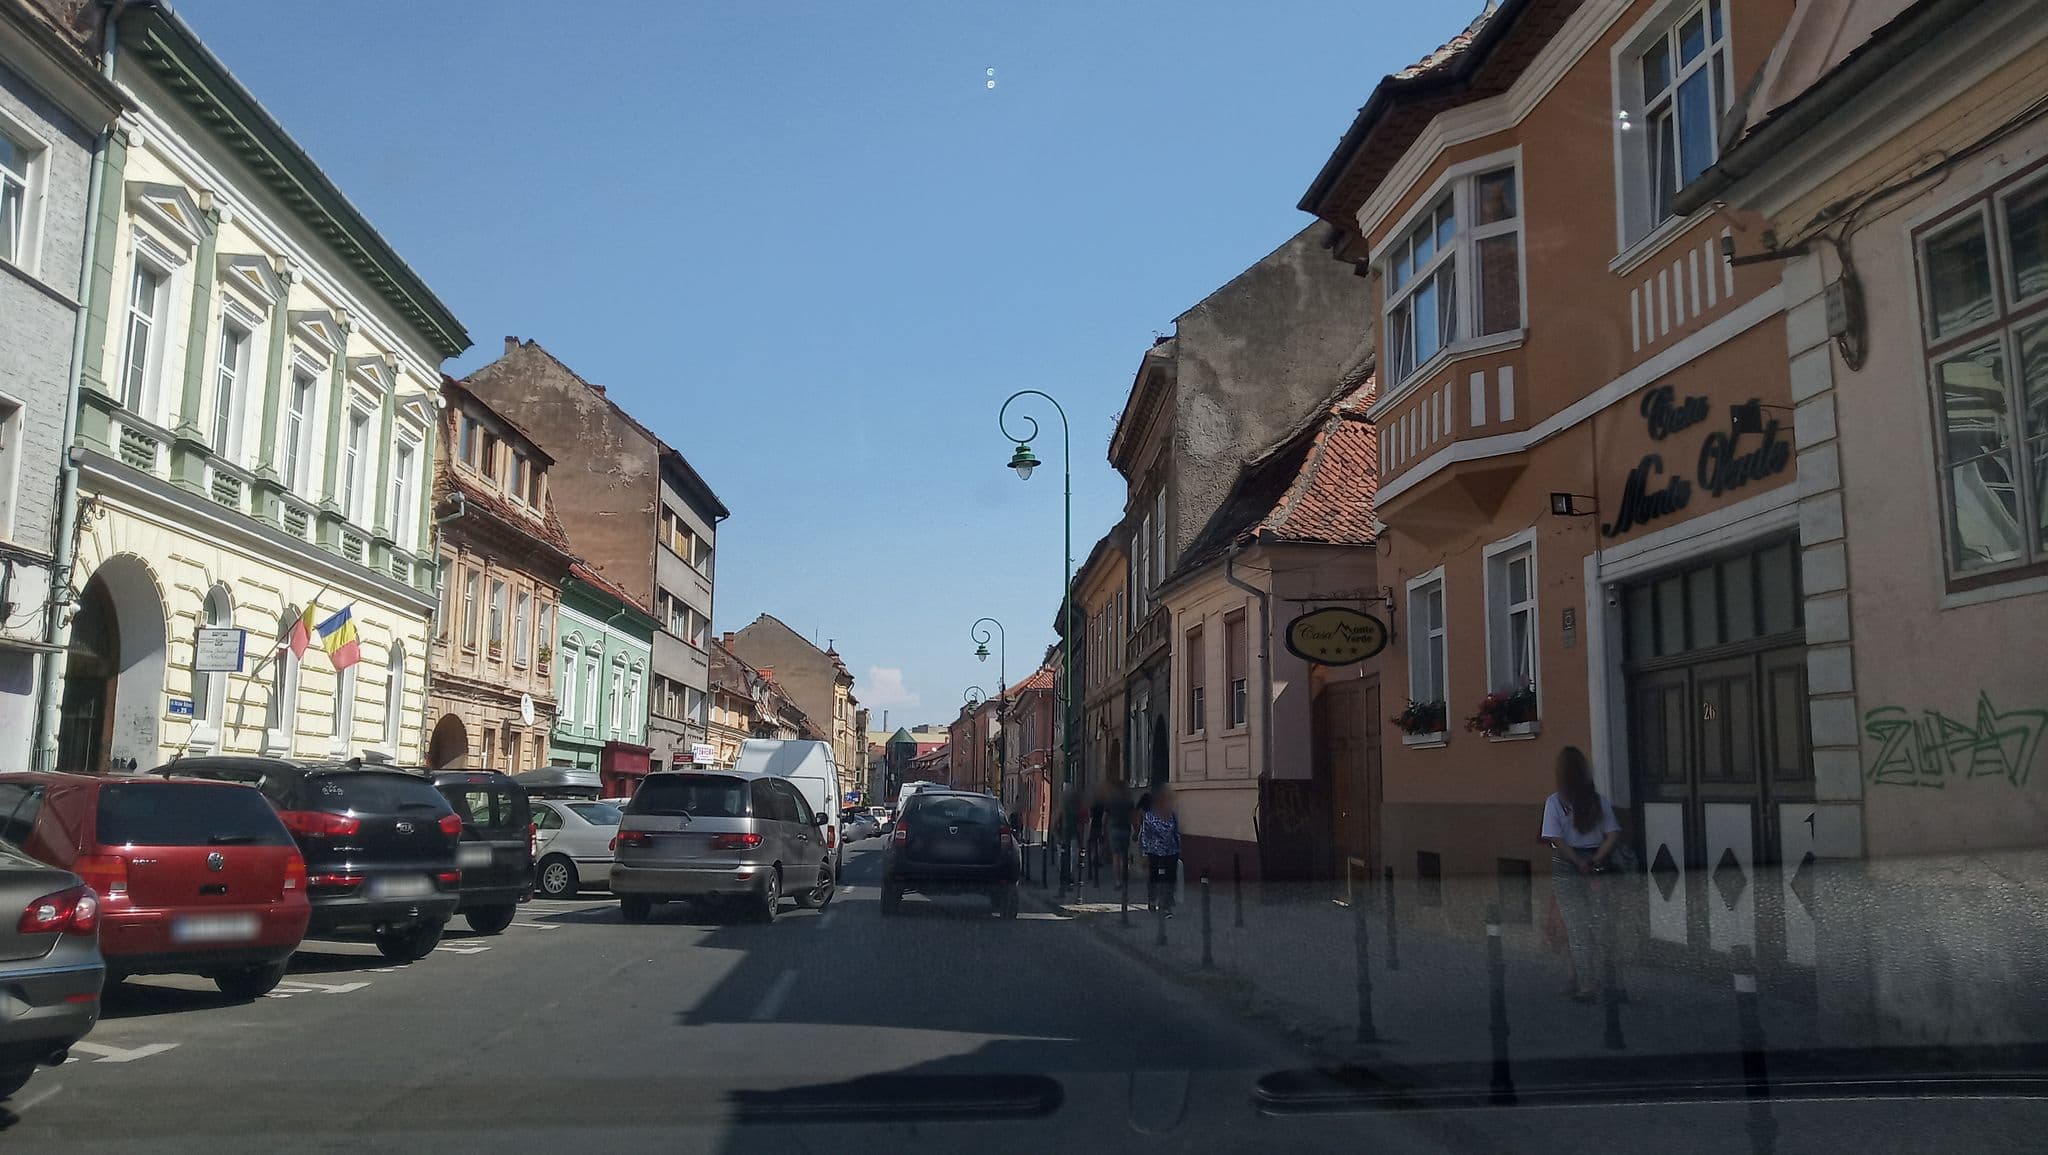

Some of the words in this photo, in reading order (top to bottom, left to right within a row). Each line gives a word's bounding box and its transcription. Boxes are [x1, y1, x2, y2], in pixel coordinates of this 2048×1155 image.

[1298, 621, 1333, 640] Casa
[1333, 621, 1373, 636] Monte
[1344, 632, 1372, 643] Verde
